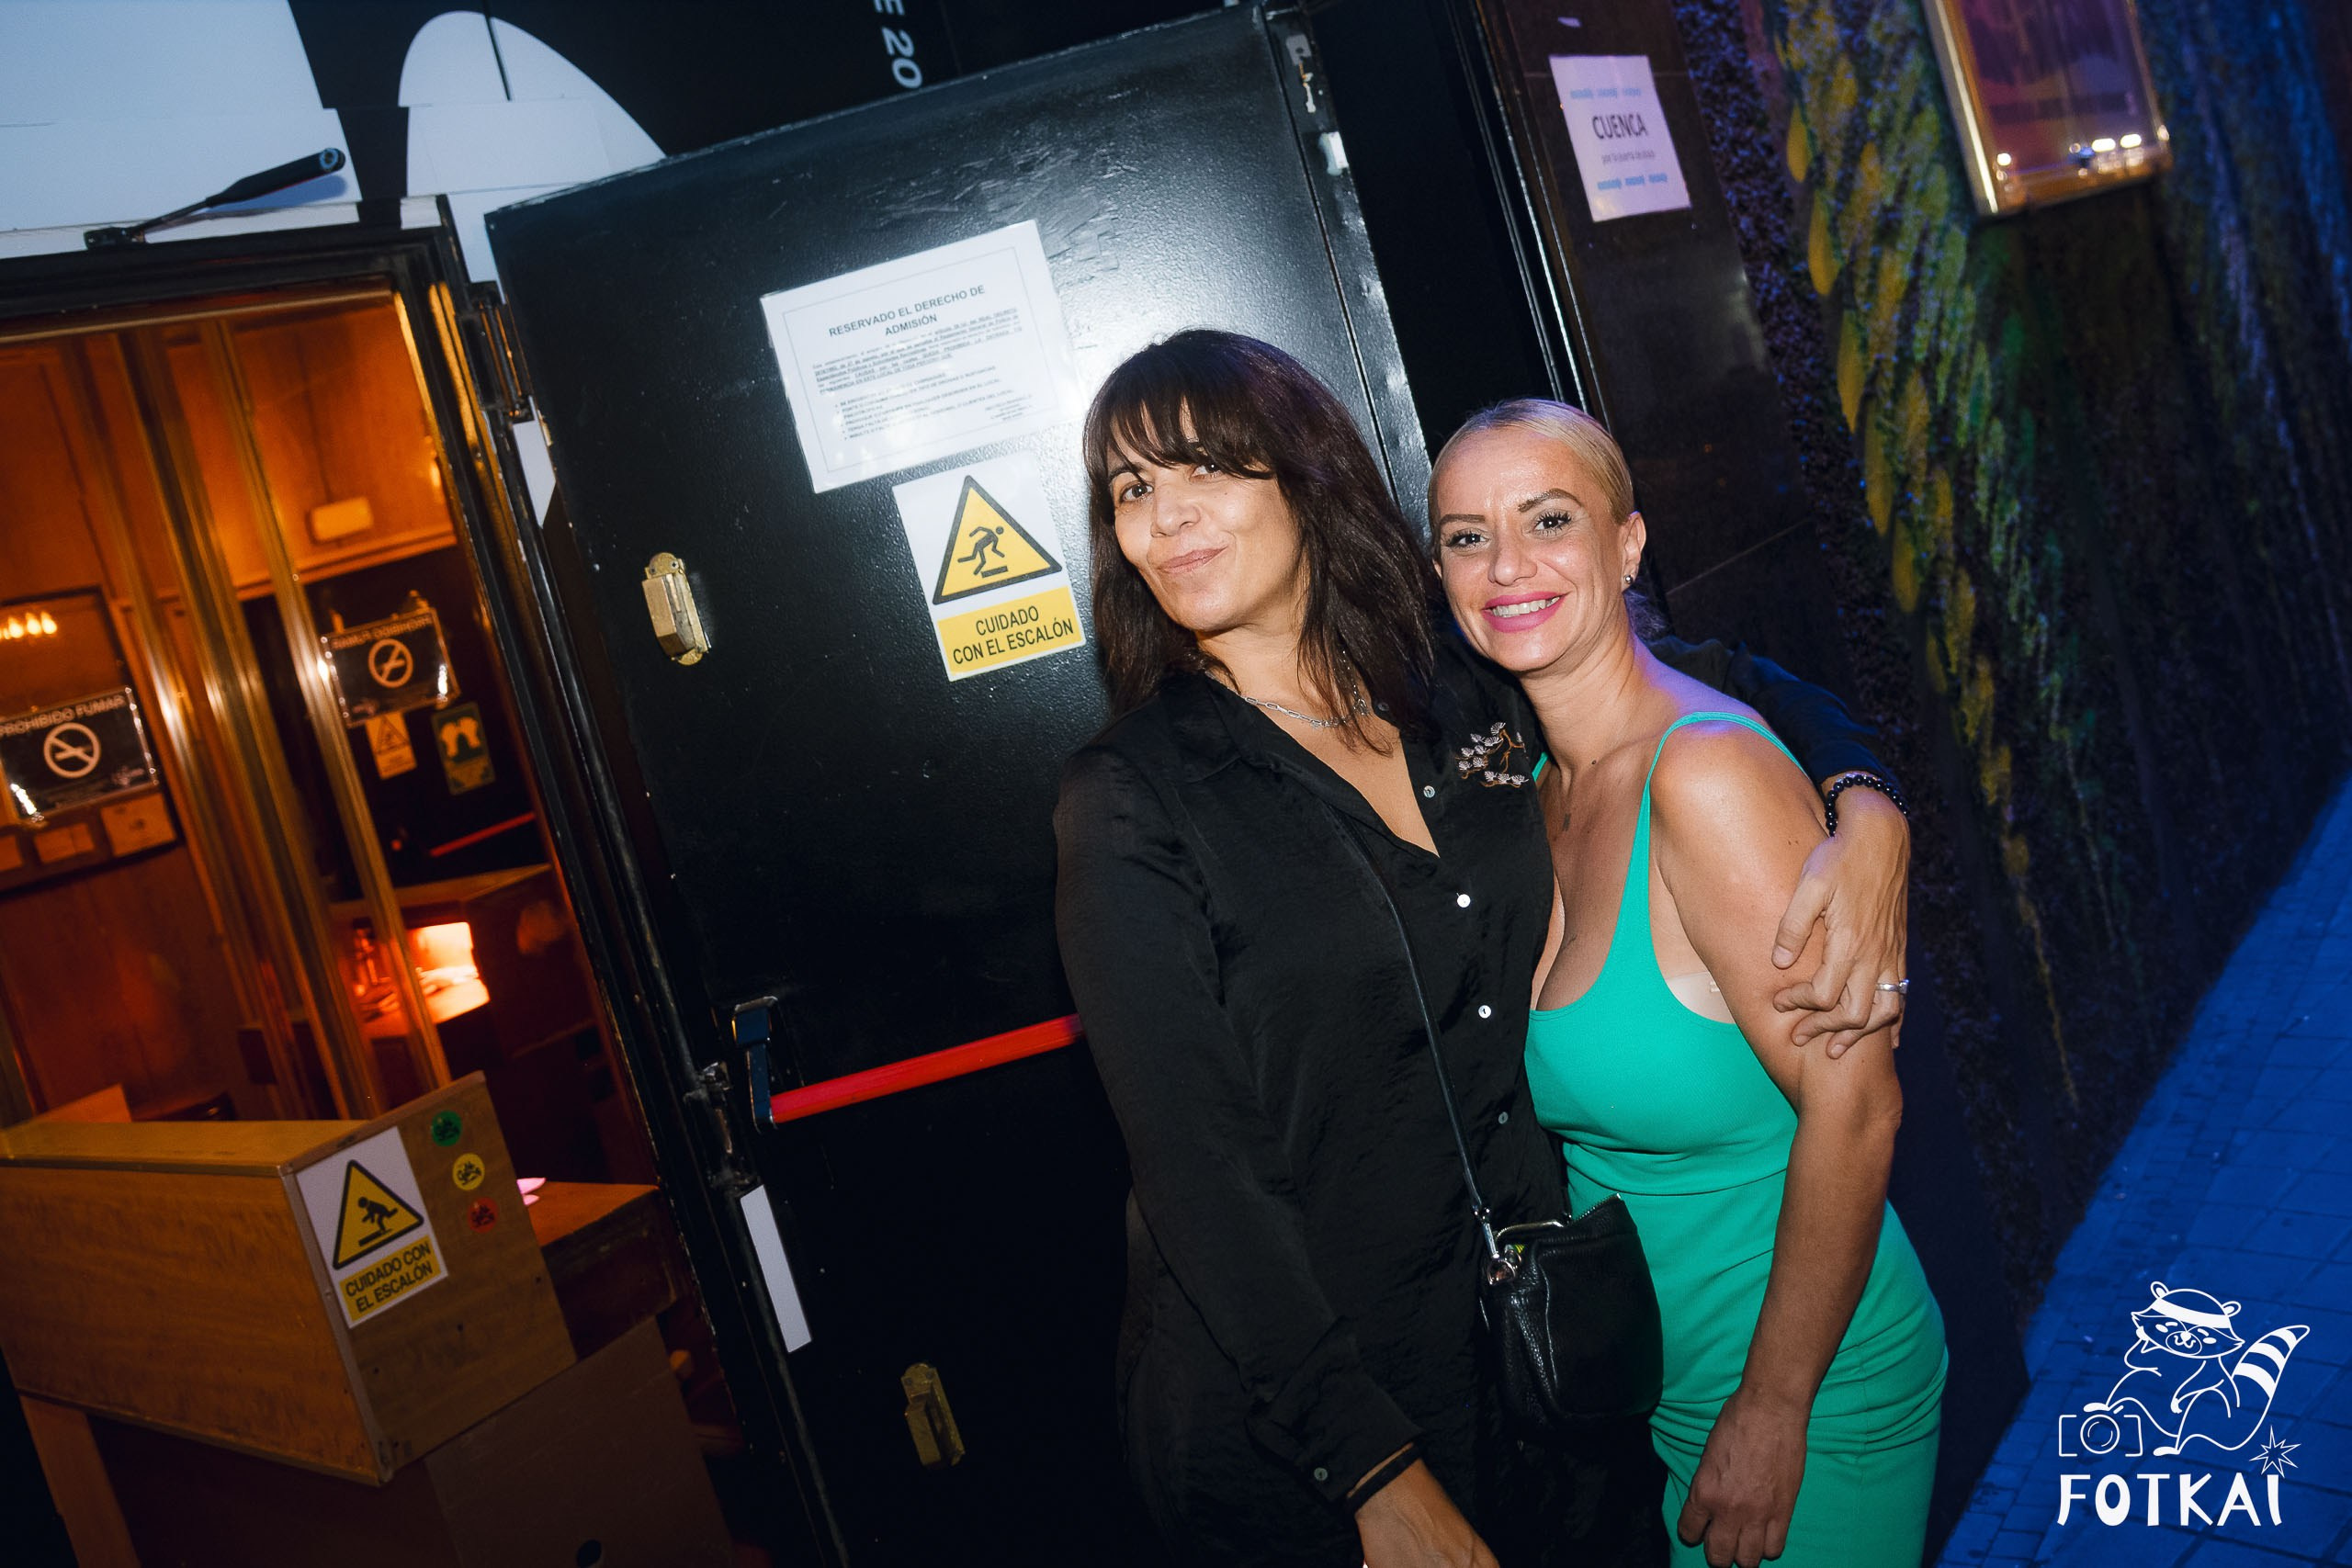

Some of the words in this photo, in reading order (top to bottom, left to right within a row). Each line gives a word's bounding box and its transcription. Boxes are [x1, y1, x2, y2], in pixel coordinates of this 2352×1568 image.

[881, 27, 922, 88] 20
[1592, 112, 1648, 139] CUENCA
[829, 311, 896, 337] RESERVADO
[898, 307, 911, 319] EL
[914, 290, 967, 313] DERECHO
[969, 285, 985, 298] DE
[885, 313, 937, 336] ADMISIÓN
[953, 643, 984, 665] CON
[988, 638, 1005, 656] EL
[1009, 617, 1073, 650] ESCALÓN
[976, 605, 1039, 636] CUIDADO
[345, 1257, 402, 1297] CUIDADO
[403, 1242, 432, 1266] CON
[356, 1295, 374, 1314] EL
[374, 1260, 433, 1300] ESCALÓN
